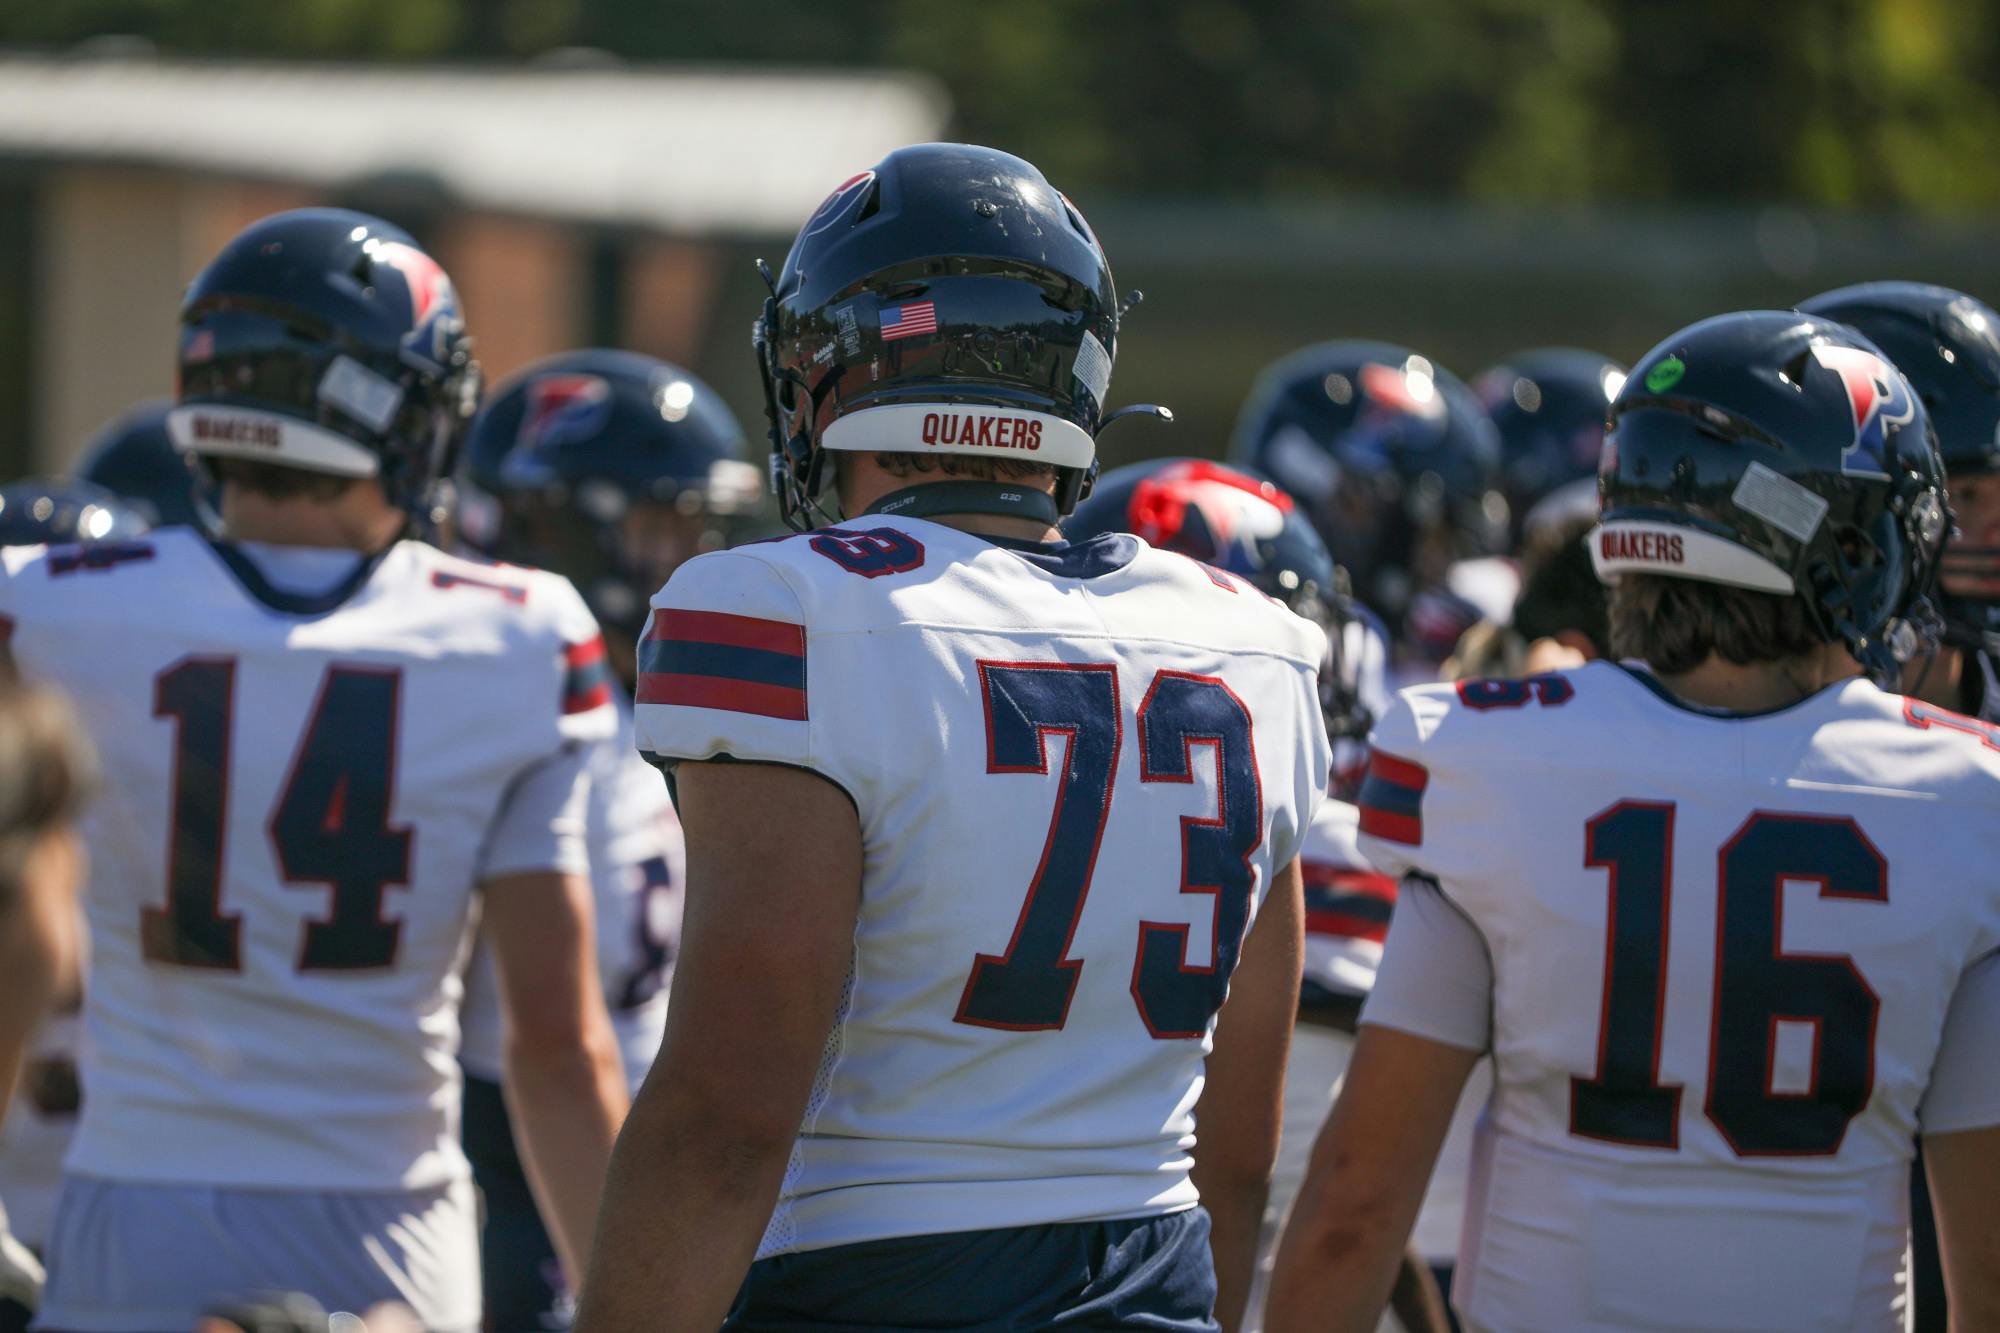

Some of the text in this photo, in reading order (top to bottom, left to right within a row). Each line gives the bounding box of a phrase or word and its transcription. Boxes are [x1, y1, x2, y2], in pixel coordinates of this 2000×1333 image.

[922, 413, 1043, 450] QUAKERS
[1602, 530, 1684, 563] QUAKERS
[138, 653, 415, 972] 14
[953, 659, 1263, 1039] 73
[1569, 798, 1889, 1157] 16
